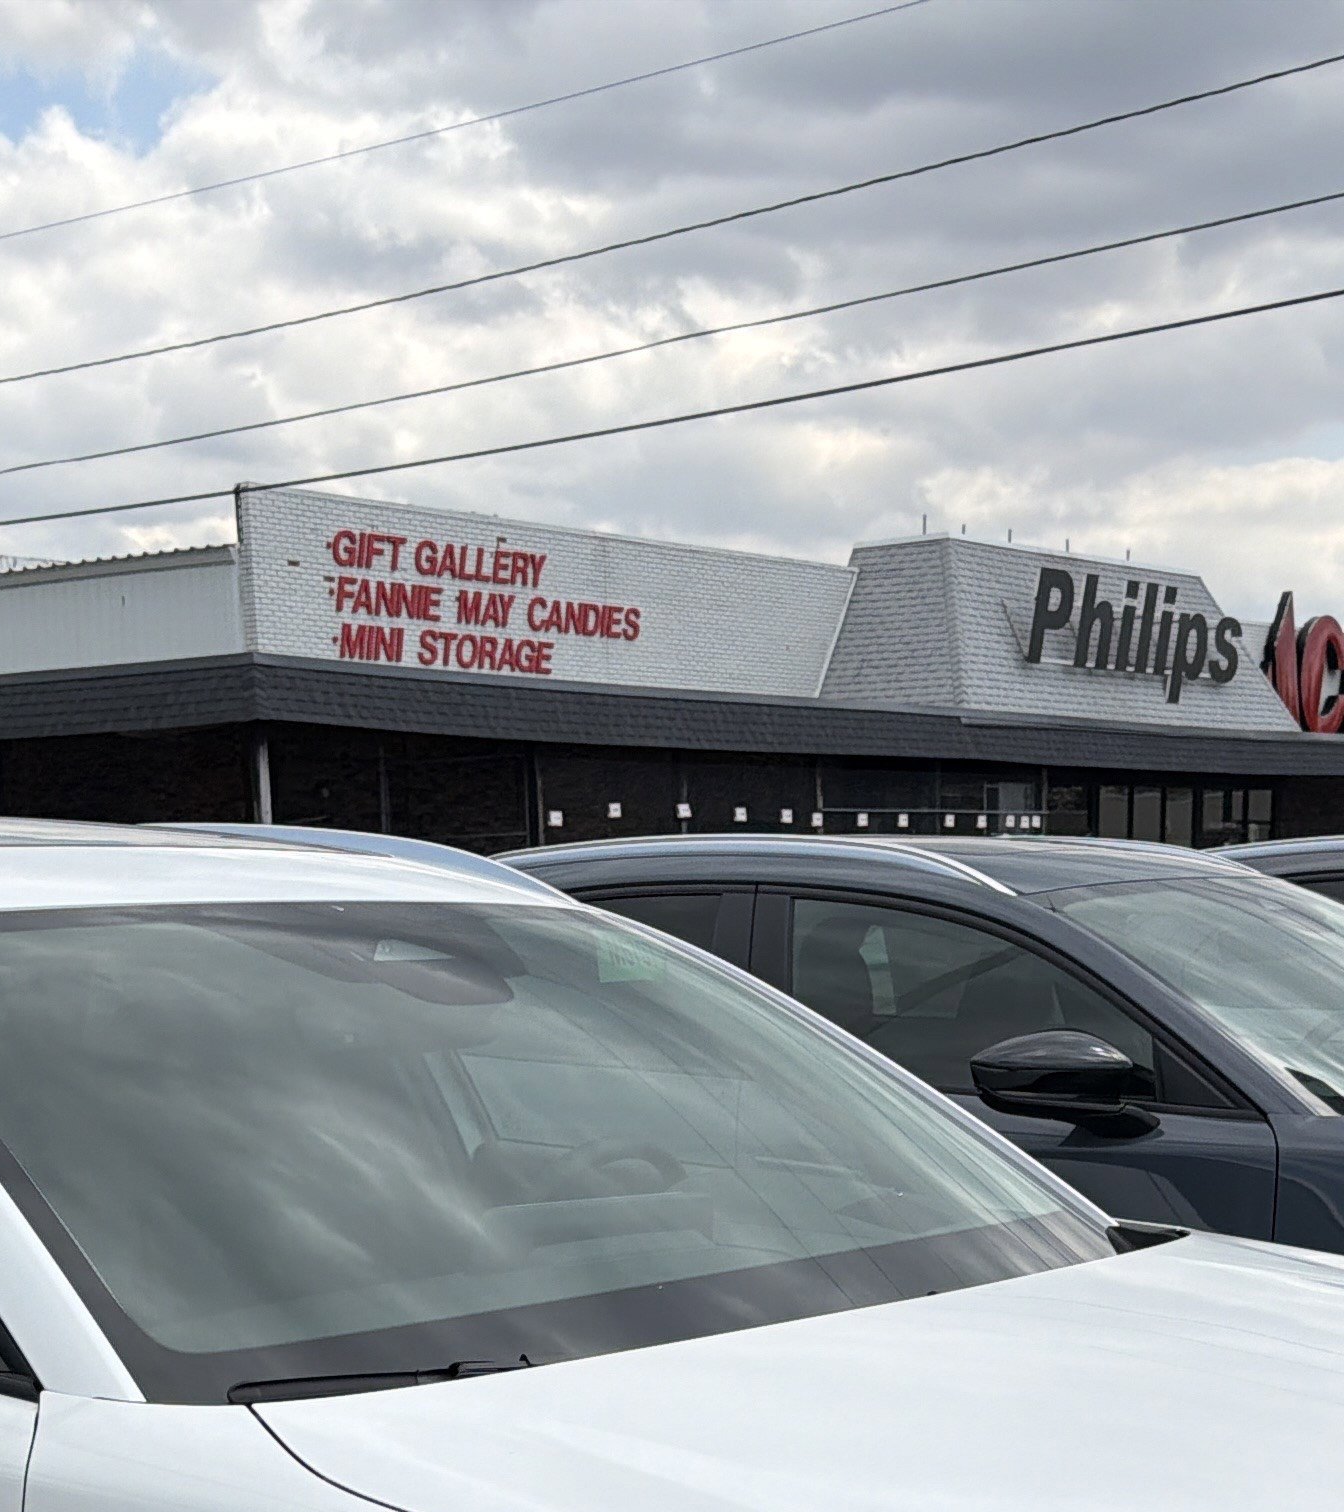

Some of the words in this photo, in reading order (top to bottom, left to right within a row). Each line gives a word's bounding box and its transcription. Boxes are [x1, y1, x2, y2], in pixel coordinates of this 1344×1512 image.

[332, 530, 406, 572] GIFT
[414, 540, 546, 588] GALLERY
[335, 575, 443, 623] FANNIE
[456, 588, 516, 628] MAY
[526, 597, 641, 641] CANDIES
[1025, 567, 1243, 704] Philips
[339, 623, 404, 662] MINI
[417, 629, 555, 675] STORAGE
